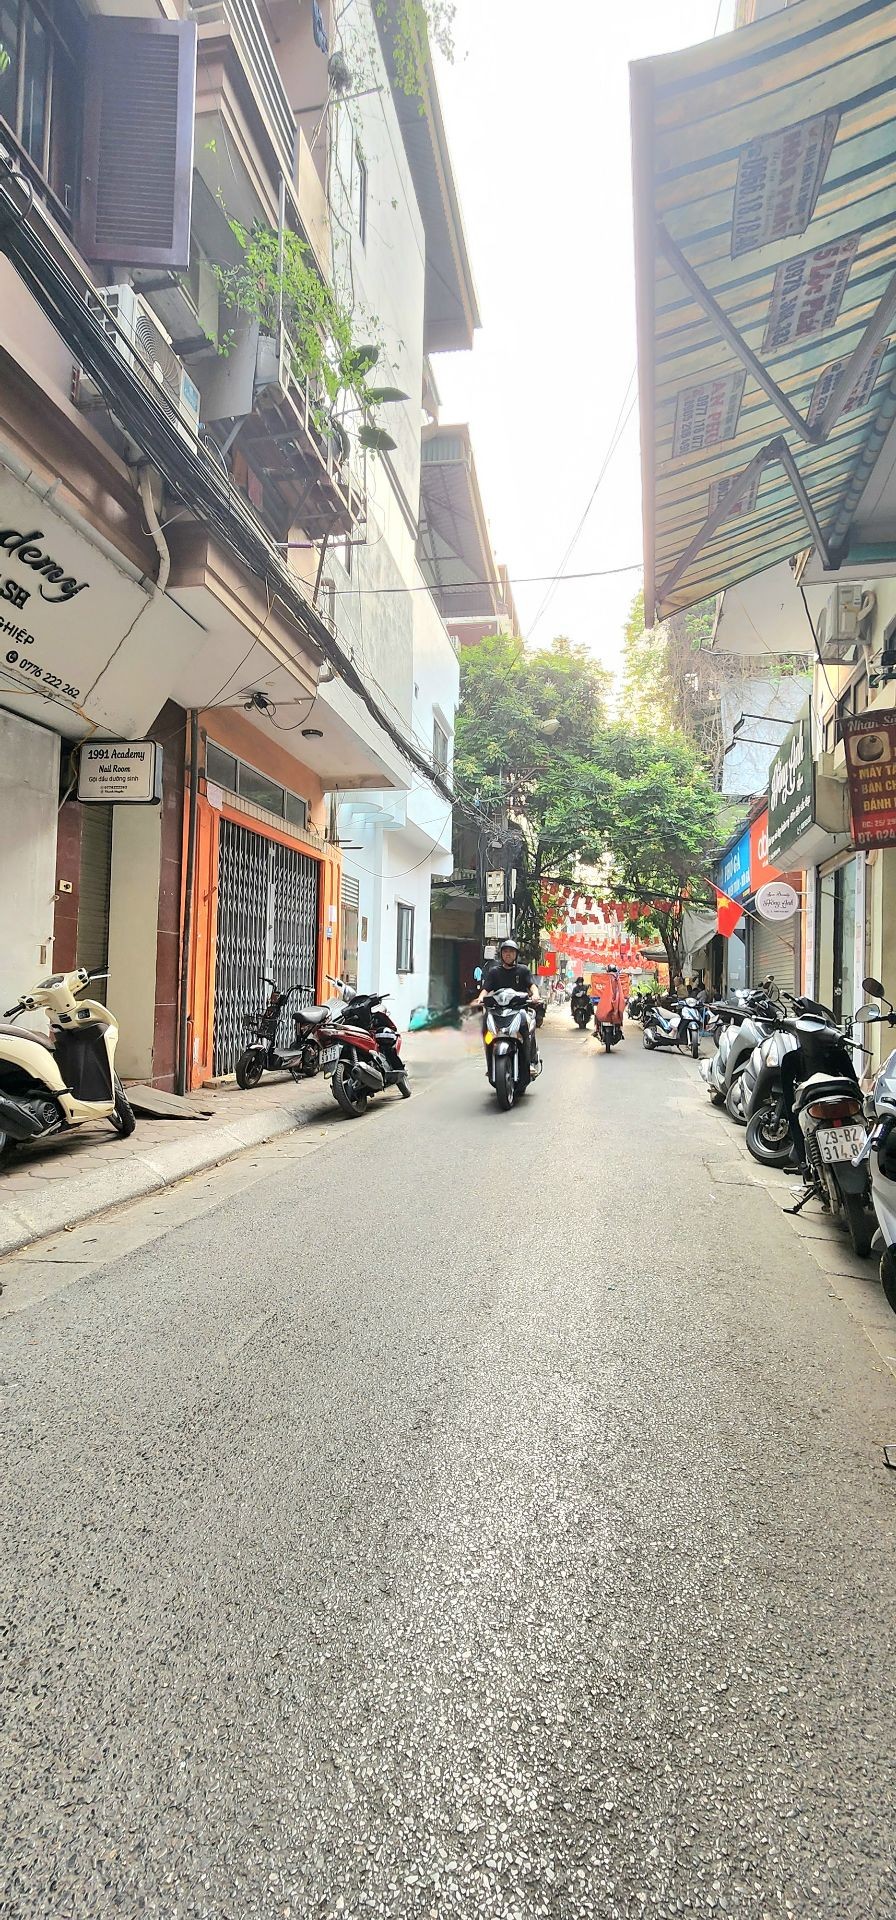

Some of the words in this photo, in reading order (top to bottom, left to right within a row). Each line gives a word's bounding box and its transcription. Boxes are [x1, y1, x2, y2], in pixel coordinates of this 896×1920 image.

[19, 659, 43, 677] 0776
[42, 672, 62, 689] 222
[61, 683, 80, 699] 262
[88, 749, 109, 760] 1991
[111, 747, 145, 761] Academy
[98, 764, 111, 773] Nail
[112, 764, 131, 773] Room
[863, 797, 892, 812] ĐÁNH
[824, 1128, 859, 1145] 29-B2
